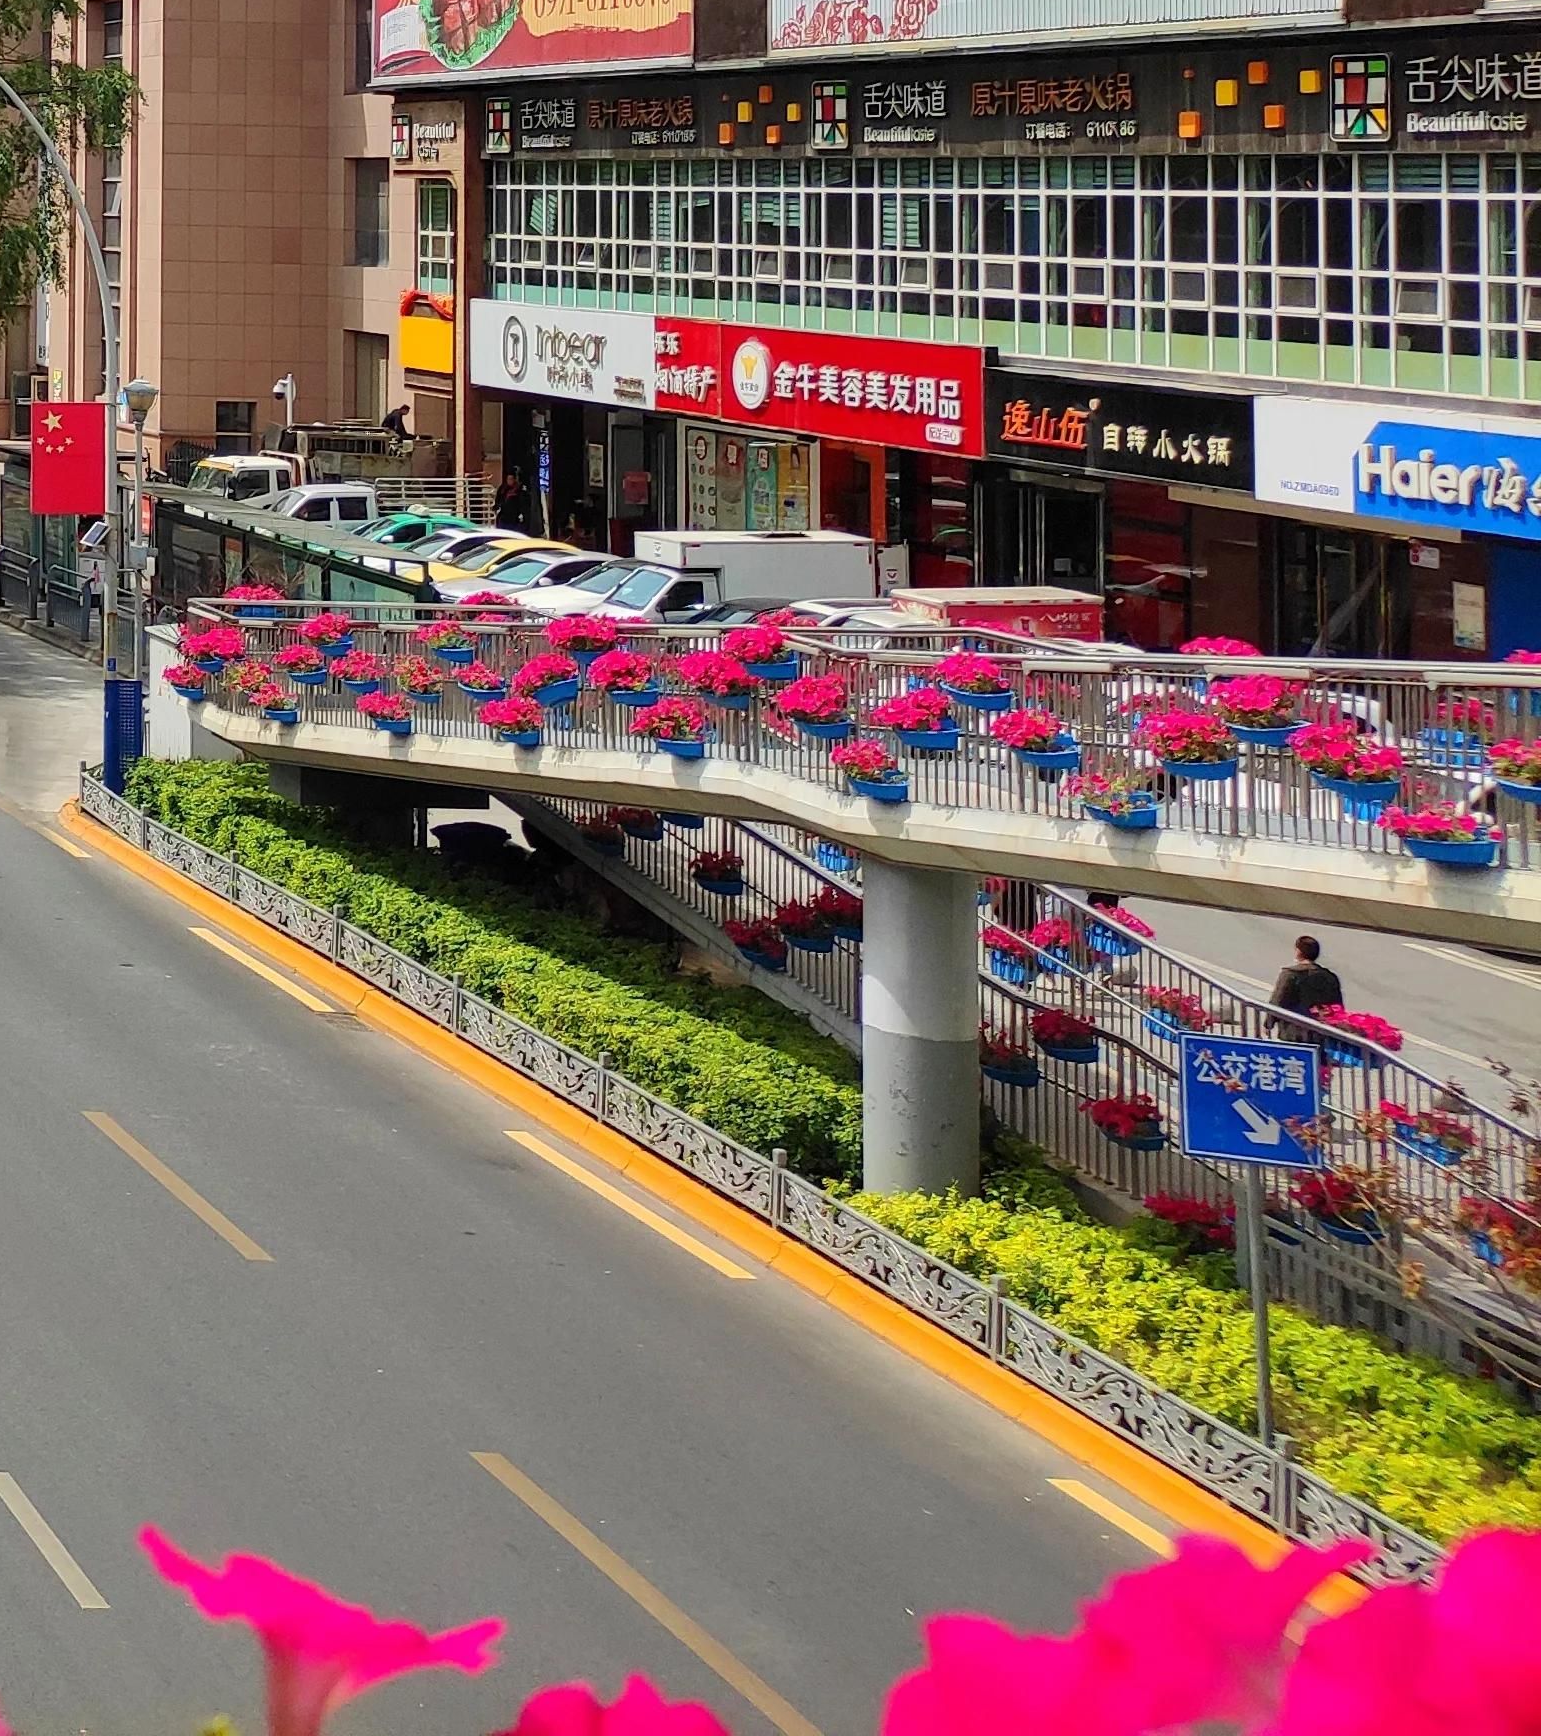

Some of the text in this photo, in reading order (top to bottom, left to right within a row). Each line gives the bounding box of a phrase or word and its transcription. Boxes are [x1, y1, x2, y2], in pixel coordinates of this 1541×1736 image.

[863, 73, 1133, 119] 舌尖味道 原汁原味老火锅
[1405, 52, 1541, 103] 舌尖味道
[413, 122, 455, 139] Beautiful
[520, 96, 694, 130] 舌尖味道 原汁原味老火锅
[773, 361, 961, 420] 金牛美容美发用品
[1103, 423, 1233, 466] 自转小火锅
[1358, 443, 1482, 506] Haier
[1193, 1049, 1306, 1095] 公交港湾
